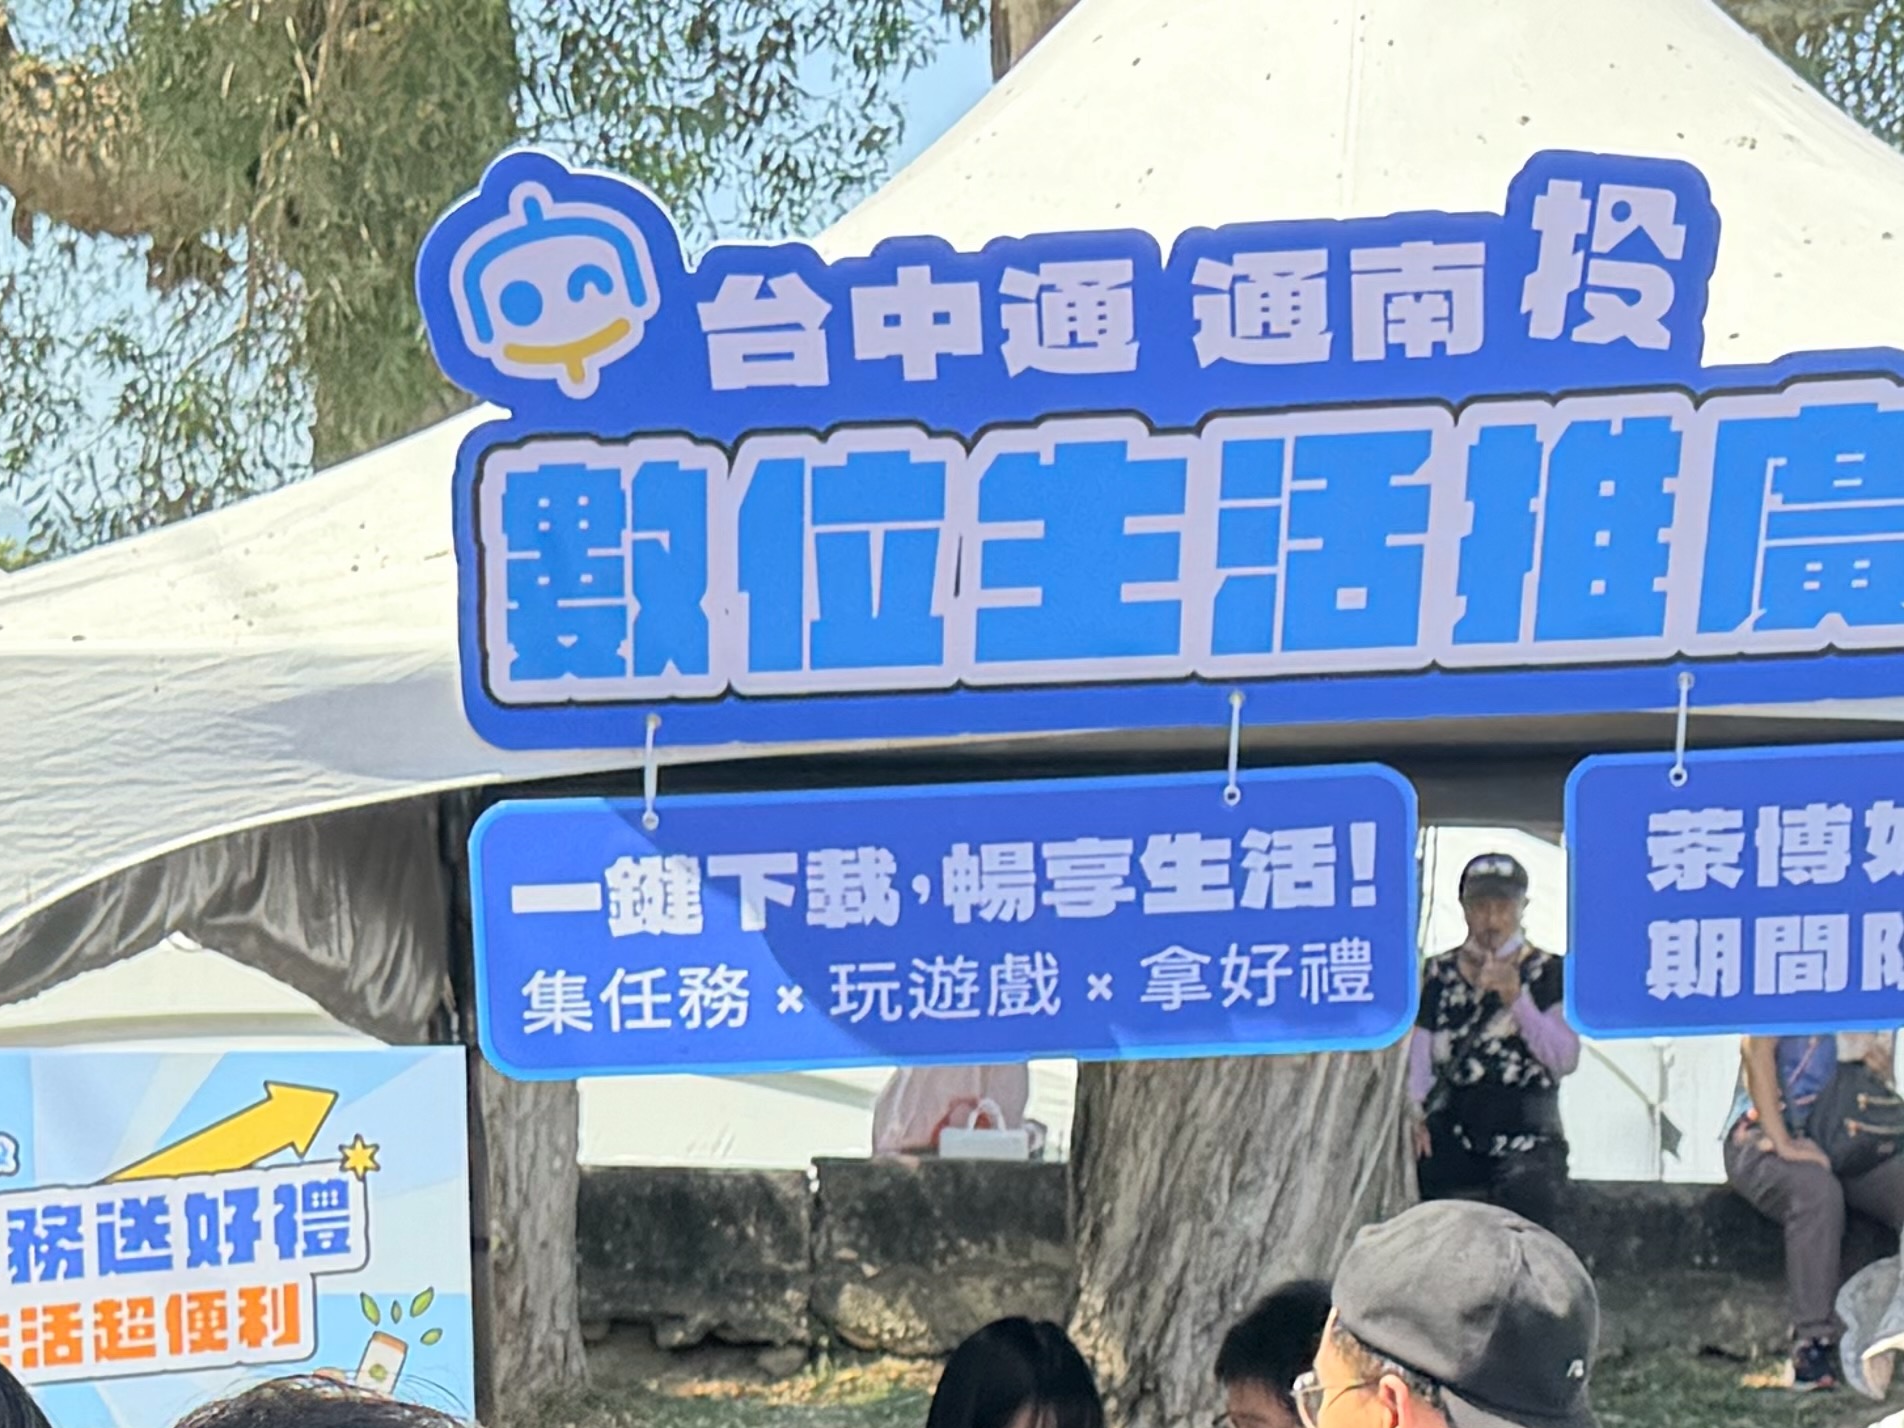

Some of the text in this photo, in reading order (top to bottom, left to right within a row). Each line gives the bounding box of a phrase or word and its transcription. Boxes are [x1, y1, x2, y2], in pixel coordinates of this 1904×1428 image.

[696, 179, 1686, 392] 台中通 通南投
[522, 965, 750, 1036] 集任務
[830, 951, 1061, 1023] 玩遊戲
[1140, 936, 1375, 1011] 拿好禮
